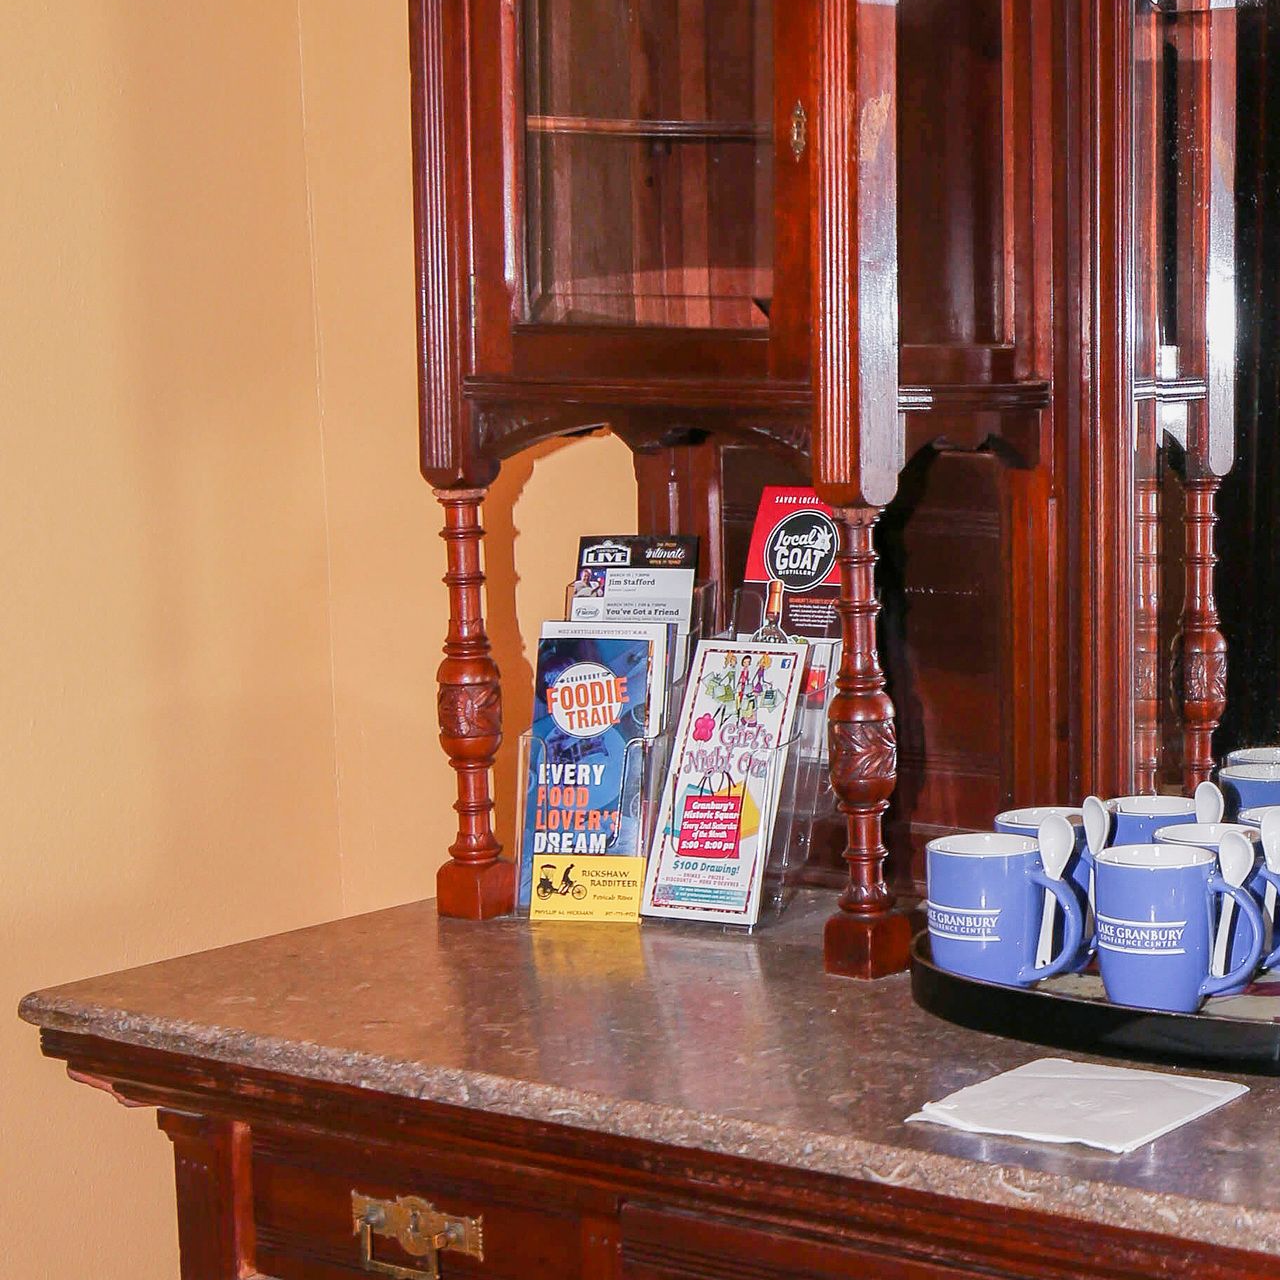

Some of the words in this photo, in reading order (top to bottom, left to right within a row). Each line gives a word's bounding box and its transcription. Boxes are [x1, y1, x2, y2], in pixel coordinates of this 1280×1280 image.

[775, 496, 797, 504] SAVOR
[799, 496, 819, 505] LOCAL
[773, 528, 818, 551] Local
[587, 552, 627, 563] LIVE
[775, 548, 825, 572] GOAT
[608, 578, 621, 587] Jim
[623, 578, 655, 586] Stafford
[566, 672, 601, 683] GRANBURY
[546, 677, 630, 714] FOODIE
[565, 705, 621, 730] TRAIL
[719, 723, 773, 750] Girl's
[684, 746, 733, 777] Night
[538, 763, 606, 786] EVERY
[536, 786, 590, 807] FOOD
[692, 801, 735, 812] Granbury's
[534, 809, 623, 831] LOVER'S
[683, 810, 713, 819] Historic
[714, 811, 740, 820] Squar
[683, 821, 699, 831] Every
[699, 821, 711, 830] 2nd
[533, 832, 607, 854] DREAM
[681, 841, 699, 850] 5:00
[704, 841, 723, 850] 8:00
[581, 870, 630, 879] RICKSHAW
[673, 860, 698, 870] $100
[700, 862, 740, 876] Drawing!
[937, 913, 999, 928] GRANBURY
[1098, 921, 1115, 936] LAKE
[1116, 928, 1184, 941] GRANBURY
[1100, 934, 1141, 947] CONFERENCE
